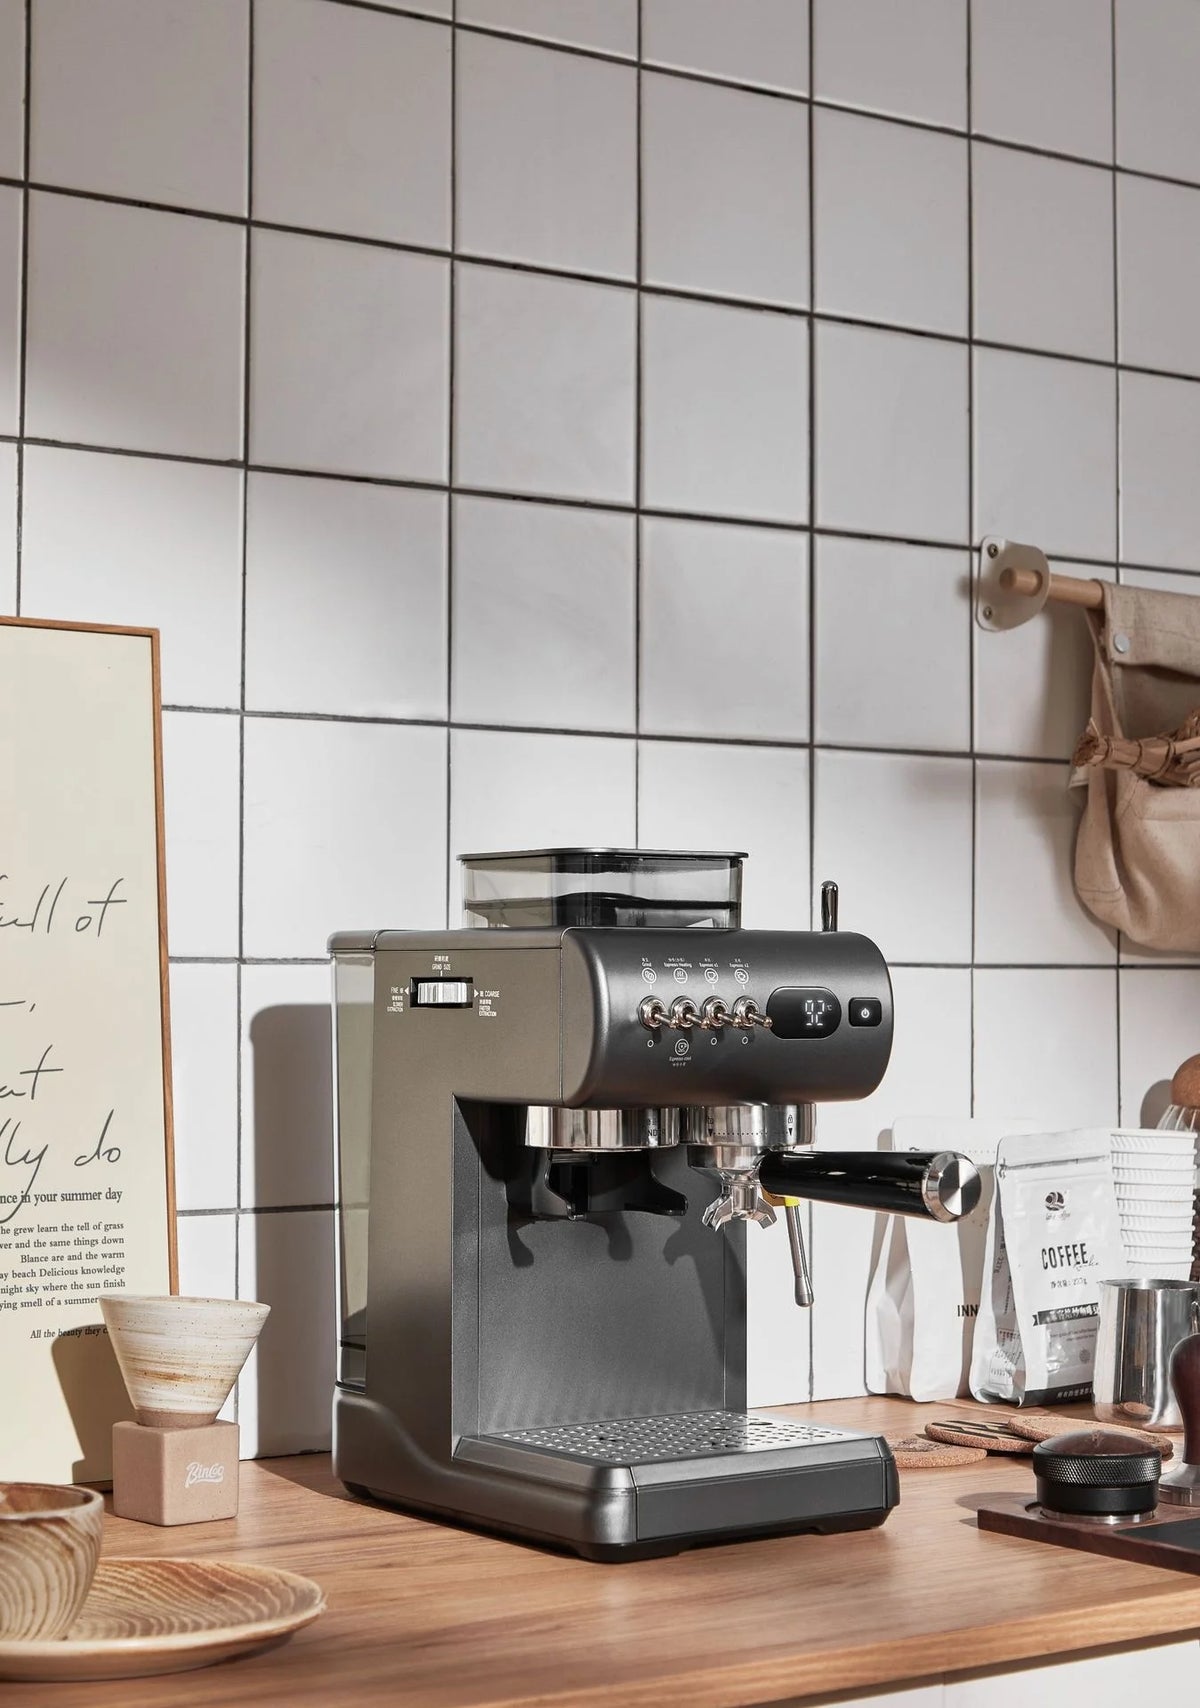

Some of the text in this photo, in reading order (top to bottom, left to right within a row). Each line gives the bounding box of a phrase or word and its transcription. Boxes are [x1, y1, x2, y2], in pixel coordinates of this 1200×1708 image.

[75, 877, 128, 937] of
[74, 1108, 121, 1167] do
[20, 1190, 31, 1204] in
[33, 1193, 58, 1206] your
[60, 1191, 102, 1202] summer
[105, 1187, 123, 1204] day
[13, 1226, 35, 1237] grew
[37, 1223, 58, 1233] learn
[61, 1222, 74, 1232] the
[77, 1221, 90, 1231] tell
[92, 1220, 103, 1231] of
[103, 1223, 124, 1232] grass
[15, 1239, 31, 1249] and
[33, 1238, 47, 1248] the
[49, 1239, 71, 1248] same
[73, 1236, 99, 1248] things
[101, 1235, 125, 1246] down
[20, 1250, 125, 1264] Blance are and the warm
[1041, 1242, 1088, 1270] COFFEE
[12, 1268, 37, 1279] beach
[39, 1266, 78, 1278] Delicious
[80, 1264, 126, 1276] knowledge
[25, 1283, 40, 1295] sky
[42, 1282, 68, 1292] where
[70, 1280, 84, 1291] the
[86, 1281, 101, 1290] sun
[103, 1279, 126, 1289] finish
[20, 1297, 43, 1308] smell
[45, 1296, 56, 1307] of
[56, 1298, 62, 1306] a
[63, 1296, 98, 1306] summer
[30, 1329, 42, 1339] All
[43, 1328, 56, 1338] the
[57, 1328, 82, 1338] beauty
[84, 1325, 101, 1337] they
